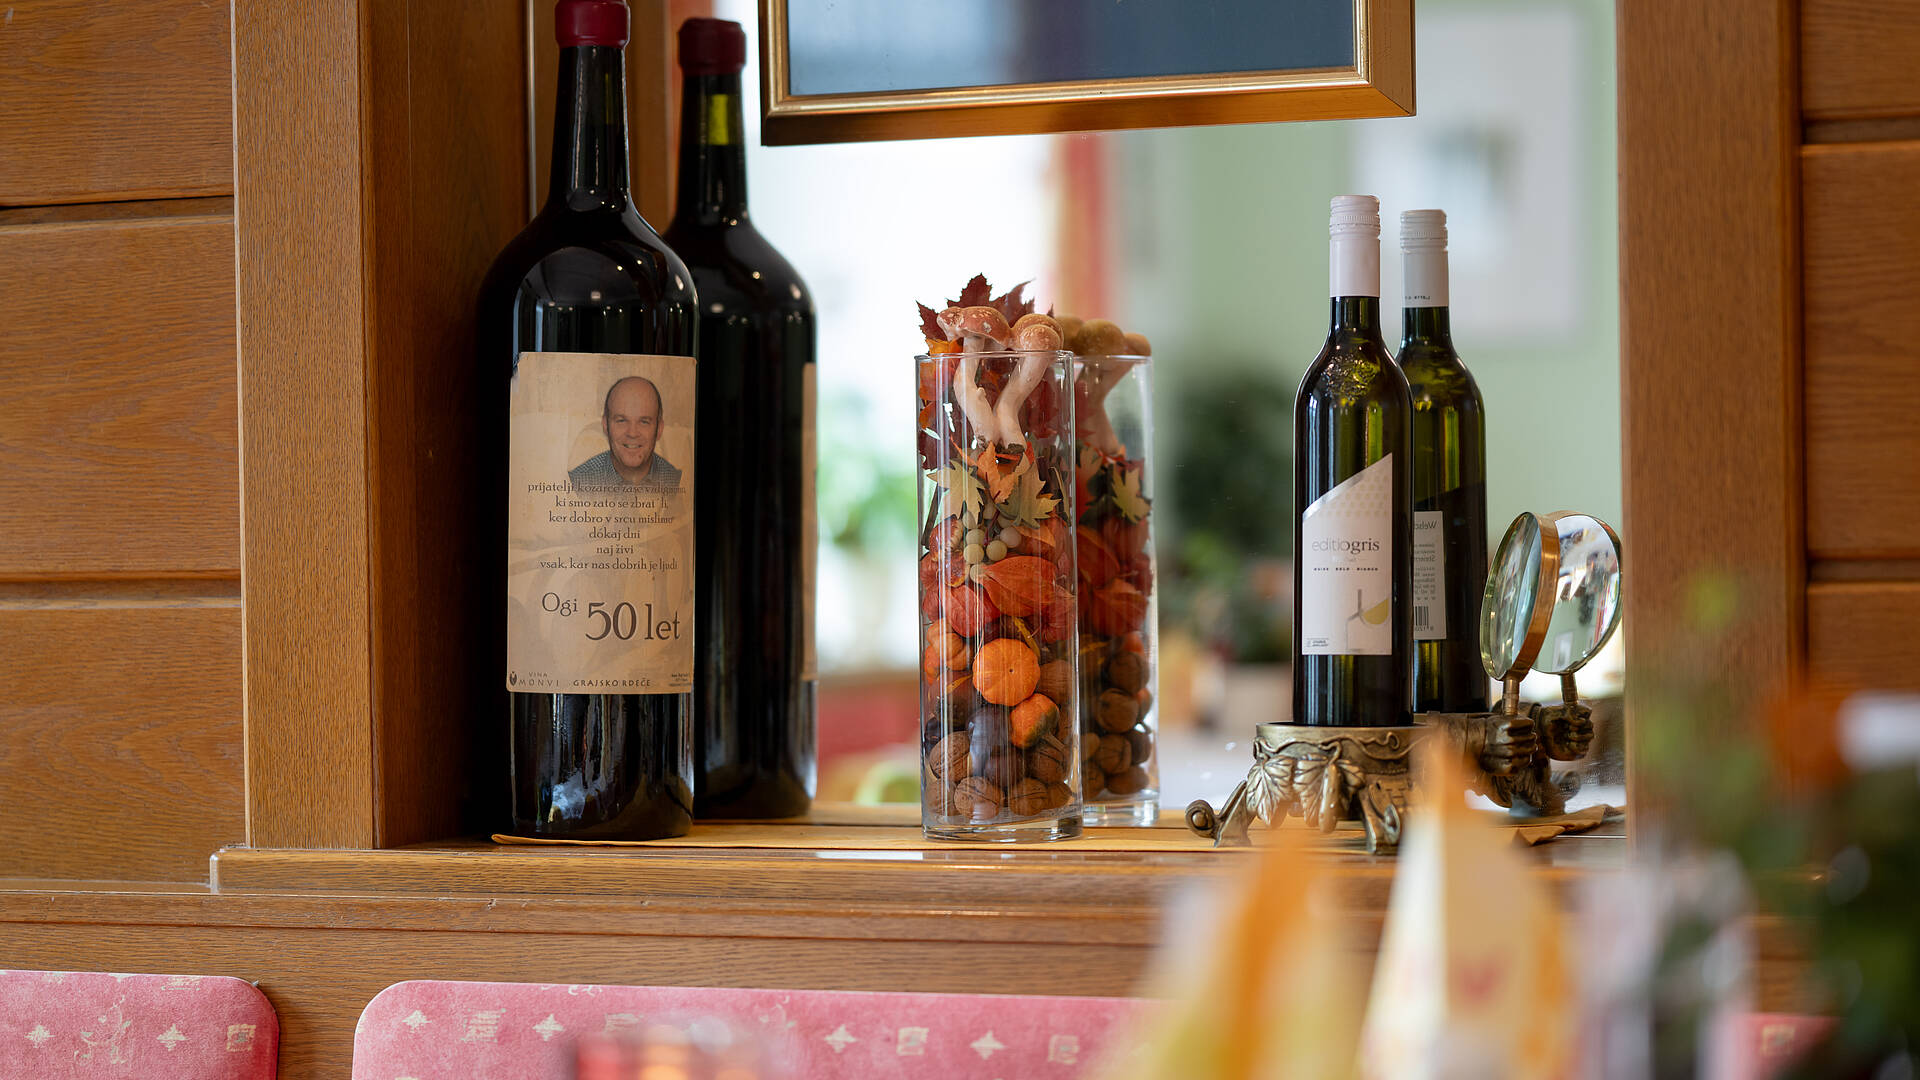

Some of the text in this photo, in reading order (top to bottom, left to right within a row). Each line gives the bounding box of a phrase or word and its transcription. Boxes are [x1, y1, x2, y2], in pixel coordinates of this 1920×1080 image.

[527, 480, 574, 494] prijatelji
[555, 495, 566, 507] ki
[568, 499, 591, 508] smo
[593, 498, 615, 508] zato
[549, 510, 567, 522] ker
[569, 511, 603, 523] dobro
[588, 527, 640, 542] dókaj dni
[596, 544, 634, 556] naj živi
[570, 558, 588, 569] kar
[591, 561, 610, 569] nas
[612, 558, 647, 570] dobrih
[648, 559, 658, 572] je
[659, 558, 678, 571] ljudi
[542, 592, 578, 616] Ogi
[585, 602, 681, 640] 50 let
[622, 677, 651, 687] RDEČE
